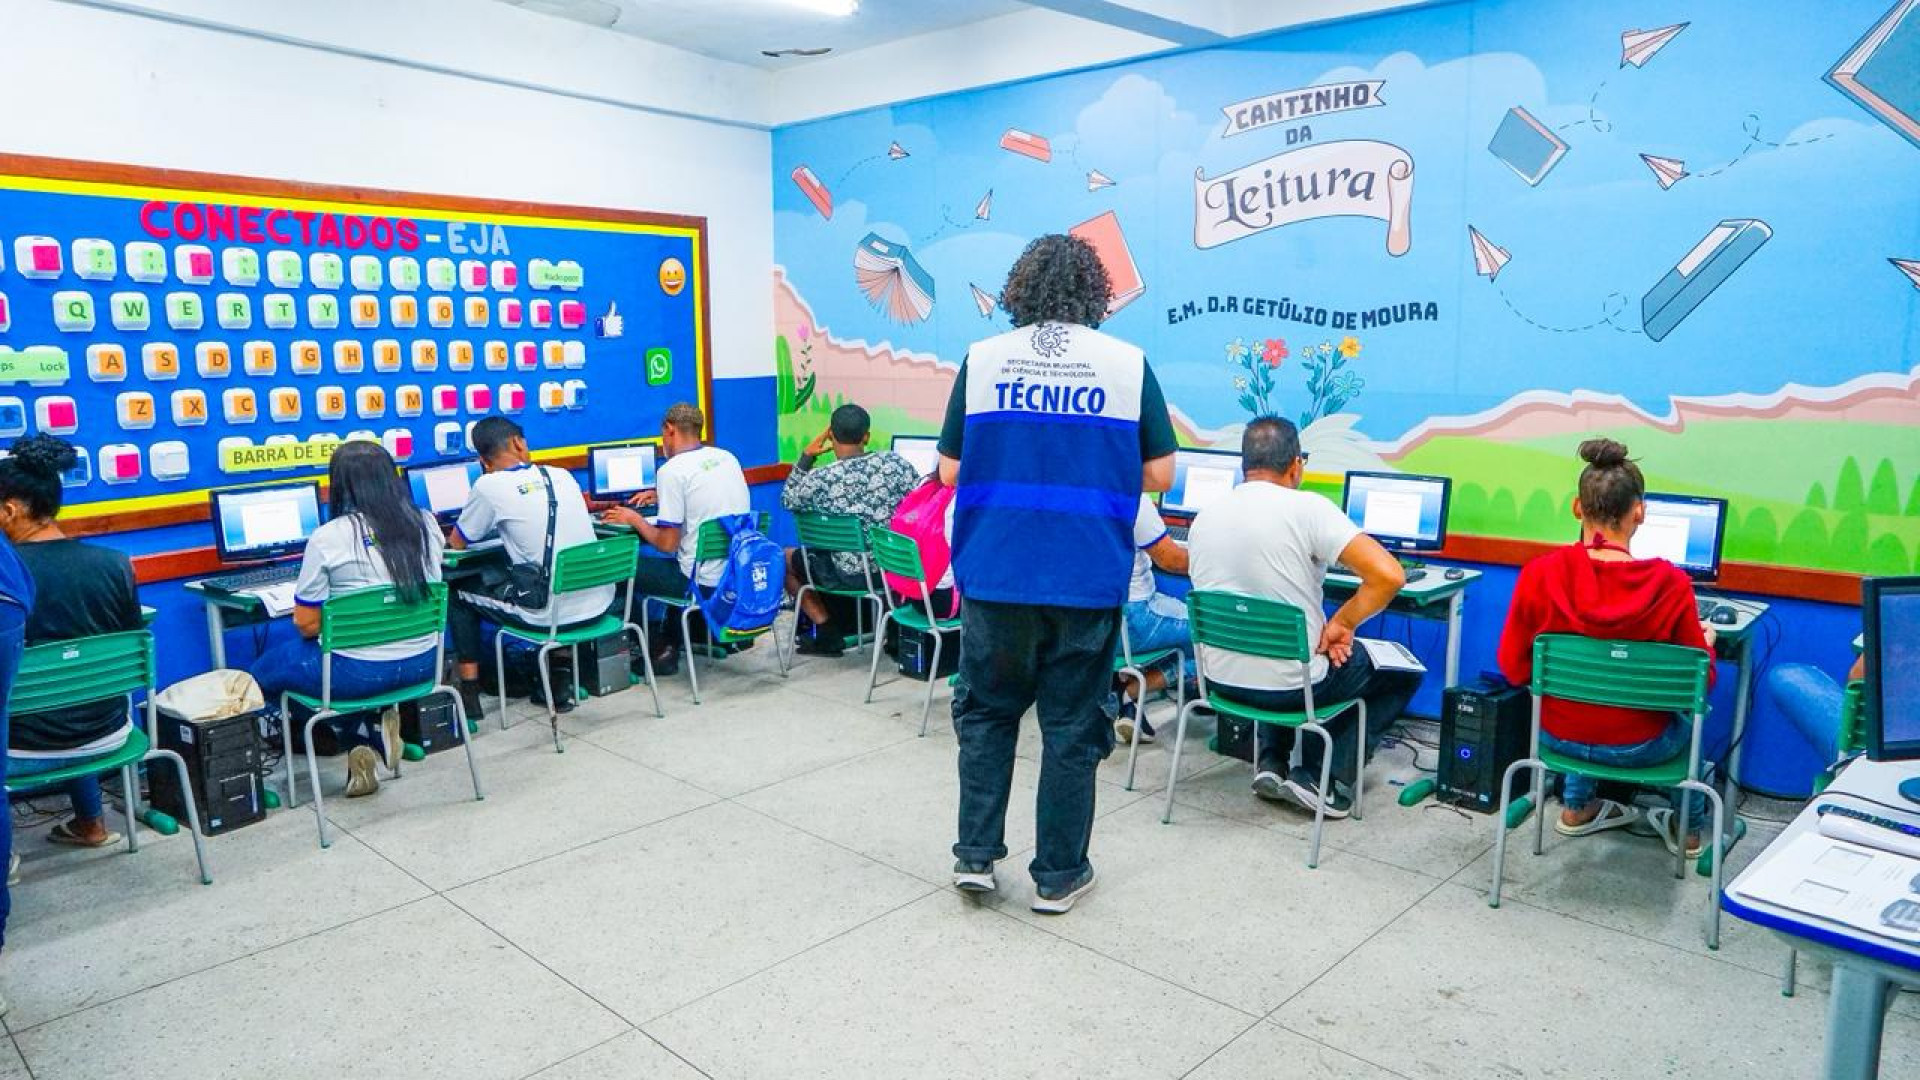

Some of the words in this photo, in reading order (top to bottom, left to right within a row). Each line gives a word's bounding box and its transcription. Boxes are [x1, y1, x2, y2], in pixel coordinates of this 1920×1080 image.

[1234, 83, 1370, 130] CANTINHO
[1285, 125, 1313, 145] DA
[1204, 167, 1376, 229] Leitura
[68, 301, 87, 319] Q
[123, 301, 144, 317] W
[182, 301, 193, 316] E
[233, 302, 244, 318] R
[279, 302, 289, 317] T
[321, 302, 332, 317] Y
[363, 304, 374, 318] U
[440, 305, 451, 319] O
[477, 305, 485, 316] P
[1167, 300, 1203, 325] E.M.
[1207, 296, 1239, 313] D.R
[1331, 311, 1357, 331] DE
[1361, 302, 1439, 330] MOURA
[105, 354, 121, 370] A
[160, 352, 172, 367] S
[212, 353, 225, 367] D
[261, 351, 270, 364] F
[305, 348, 316, 361] G
[347, 349, 358, 361] H
[426, 347, 434, 359] K
[1007, 359, 1051, 368] SECRETARIA
[137, 401, 147, 415] Z
[189, 401, 201, 414] X
[241, 398, 251, 411] C
[286, 396, 297, 410] V
[331, 396, 340, 409] B
[370, 395, 380, 407] N
[407, 393, 420, 406] M
[995, 377, 1106, 415] TÉCNICO
[233, 446, 288, 465] BARRA
[294, 445, 313, 459] DE
